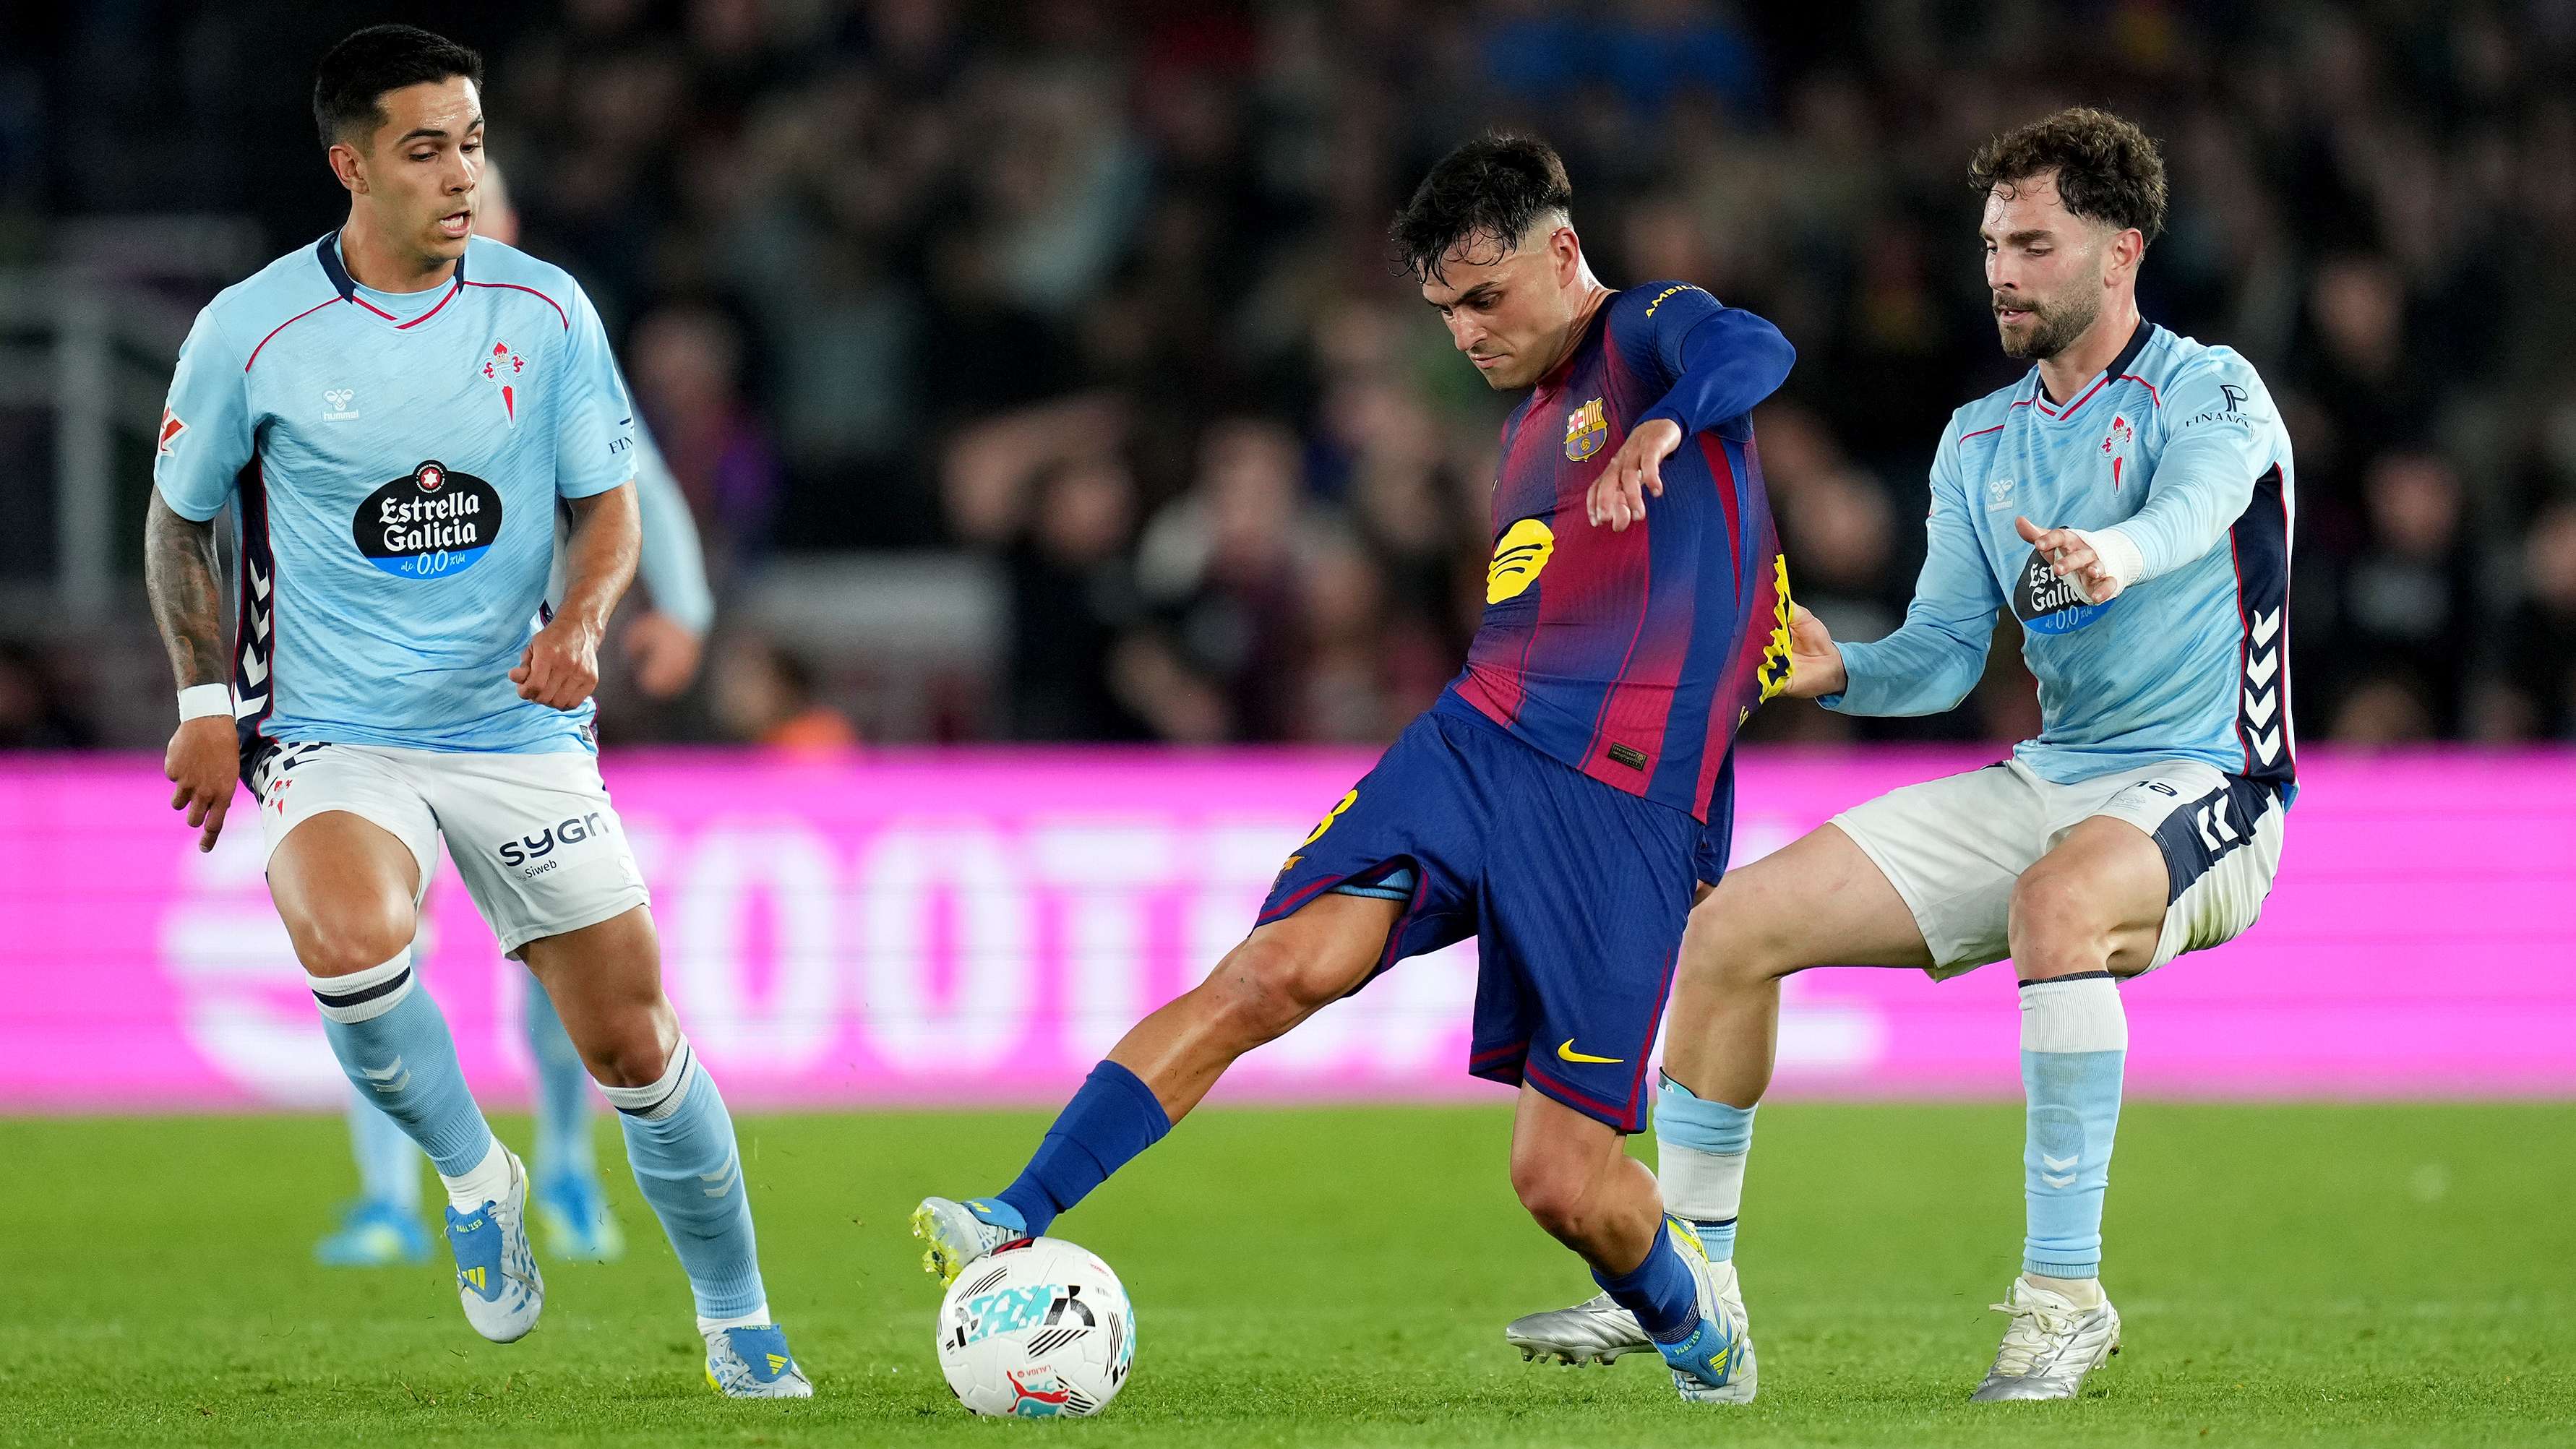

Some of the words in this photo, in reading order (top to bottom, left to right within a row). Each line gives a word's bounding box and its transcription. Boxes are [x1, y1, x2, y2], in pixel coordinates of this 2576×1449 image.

[323, 410, 359, 421] hummel
[379, 491, 480, 525] Estrella
[384, 518, 478, 551] Galicia
[416, 549, 449, 575] 0,0
[2056, 605, 2079, 629] 0,0
[525, 859, 557, 878] Siweb
